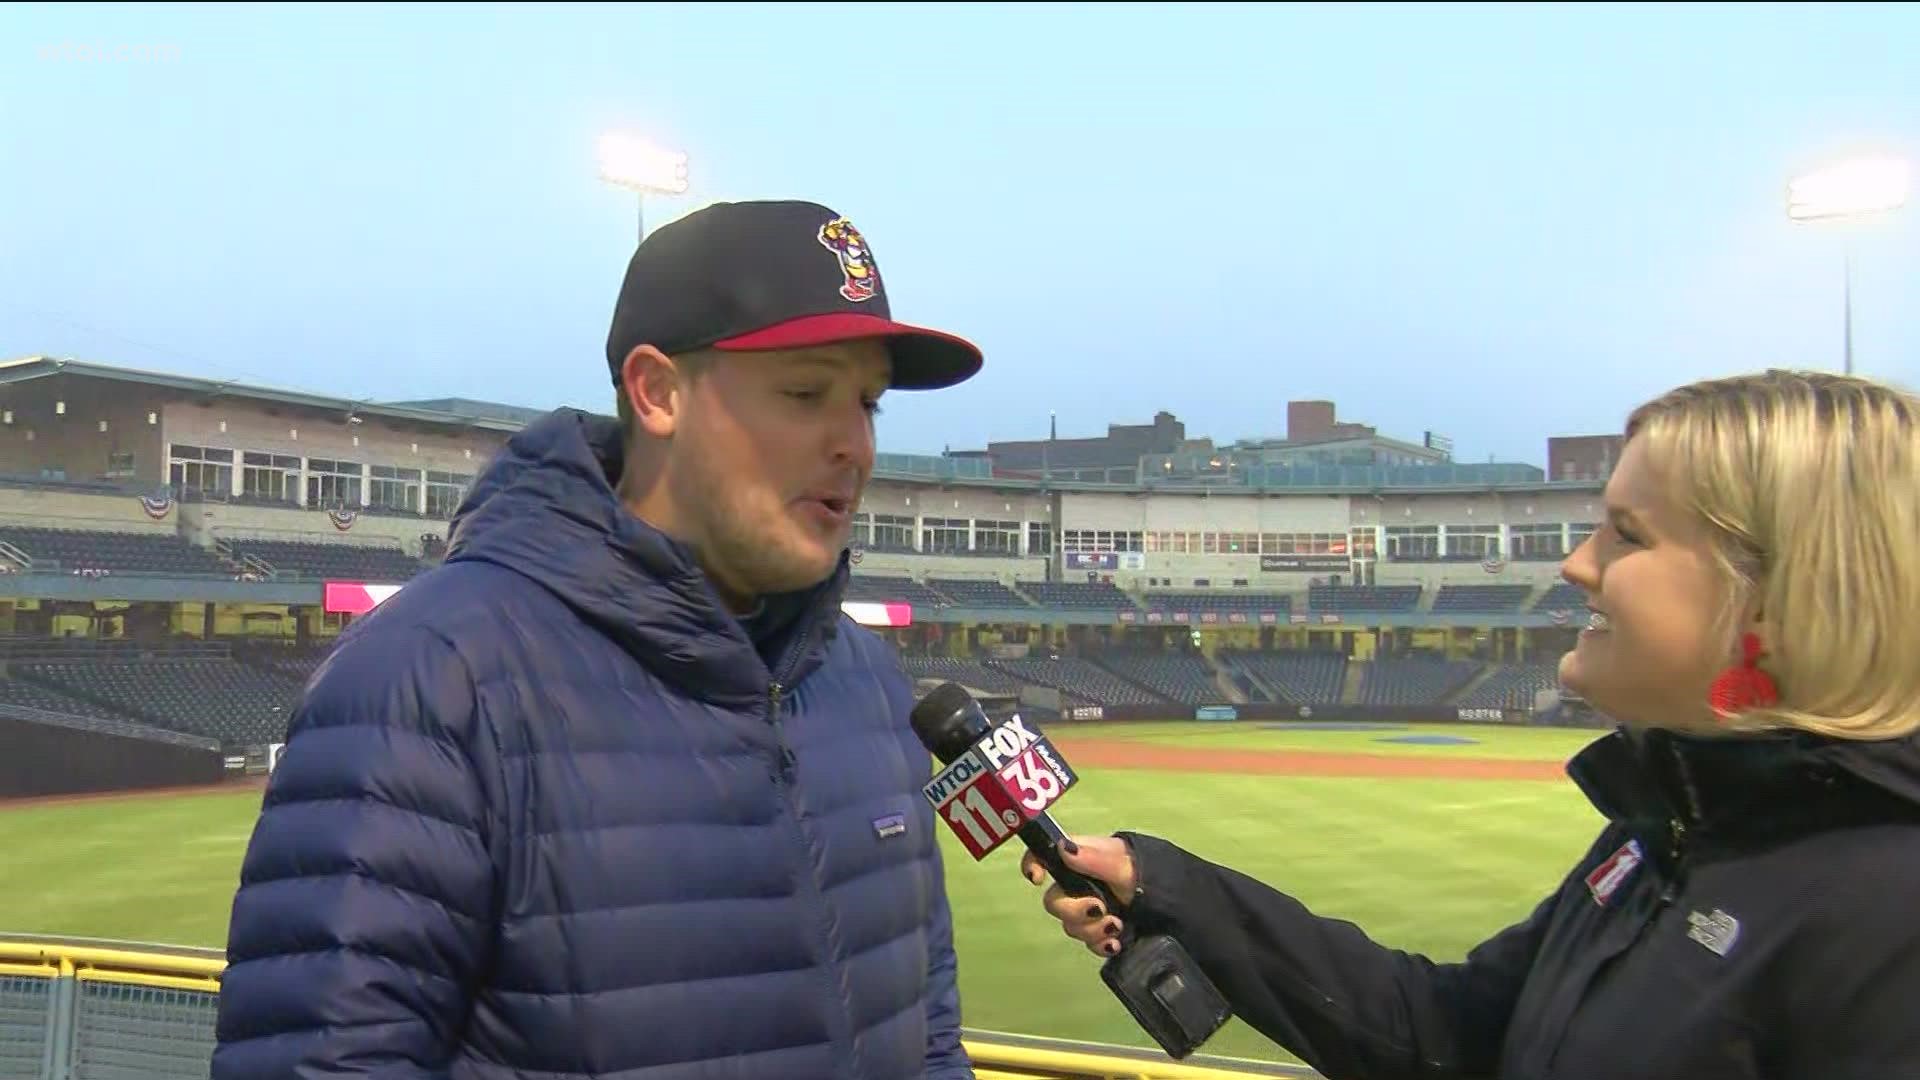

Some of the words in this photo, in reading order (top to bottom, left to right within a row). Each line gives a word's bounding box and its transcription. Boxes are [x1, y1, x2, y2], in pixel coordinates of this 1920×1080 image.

[978, 714, 1038, 769] FOX
[926, 757, 984, 804] WTOL
[1001, 752, 1060, 811] 36
[949, 788, 1009, 850] 11
